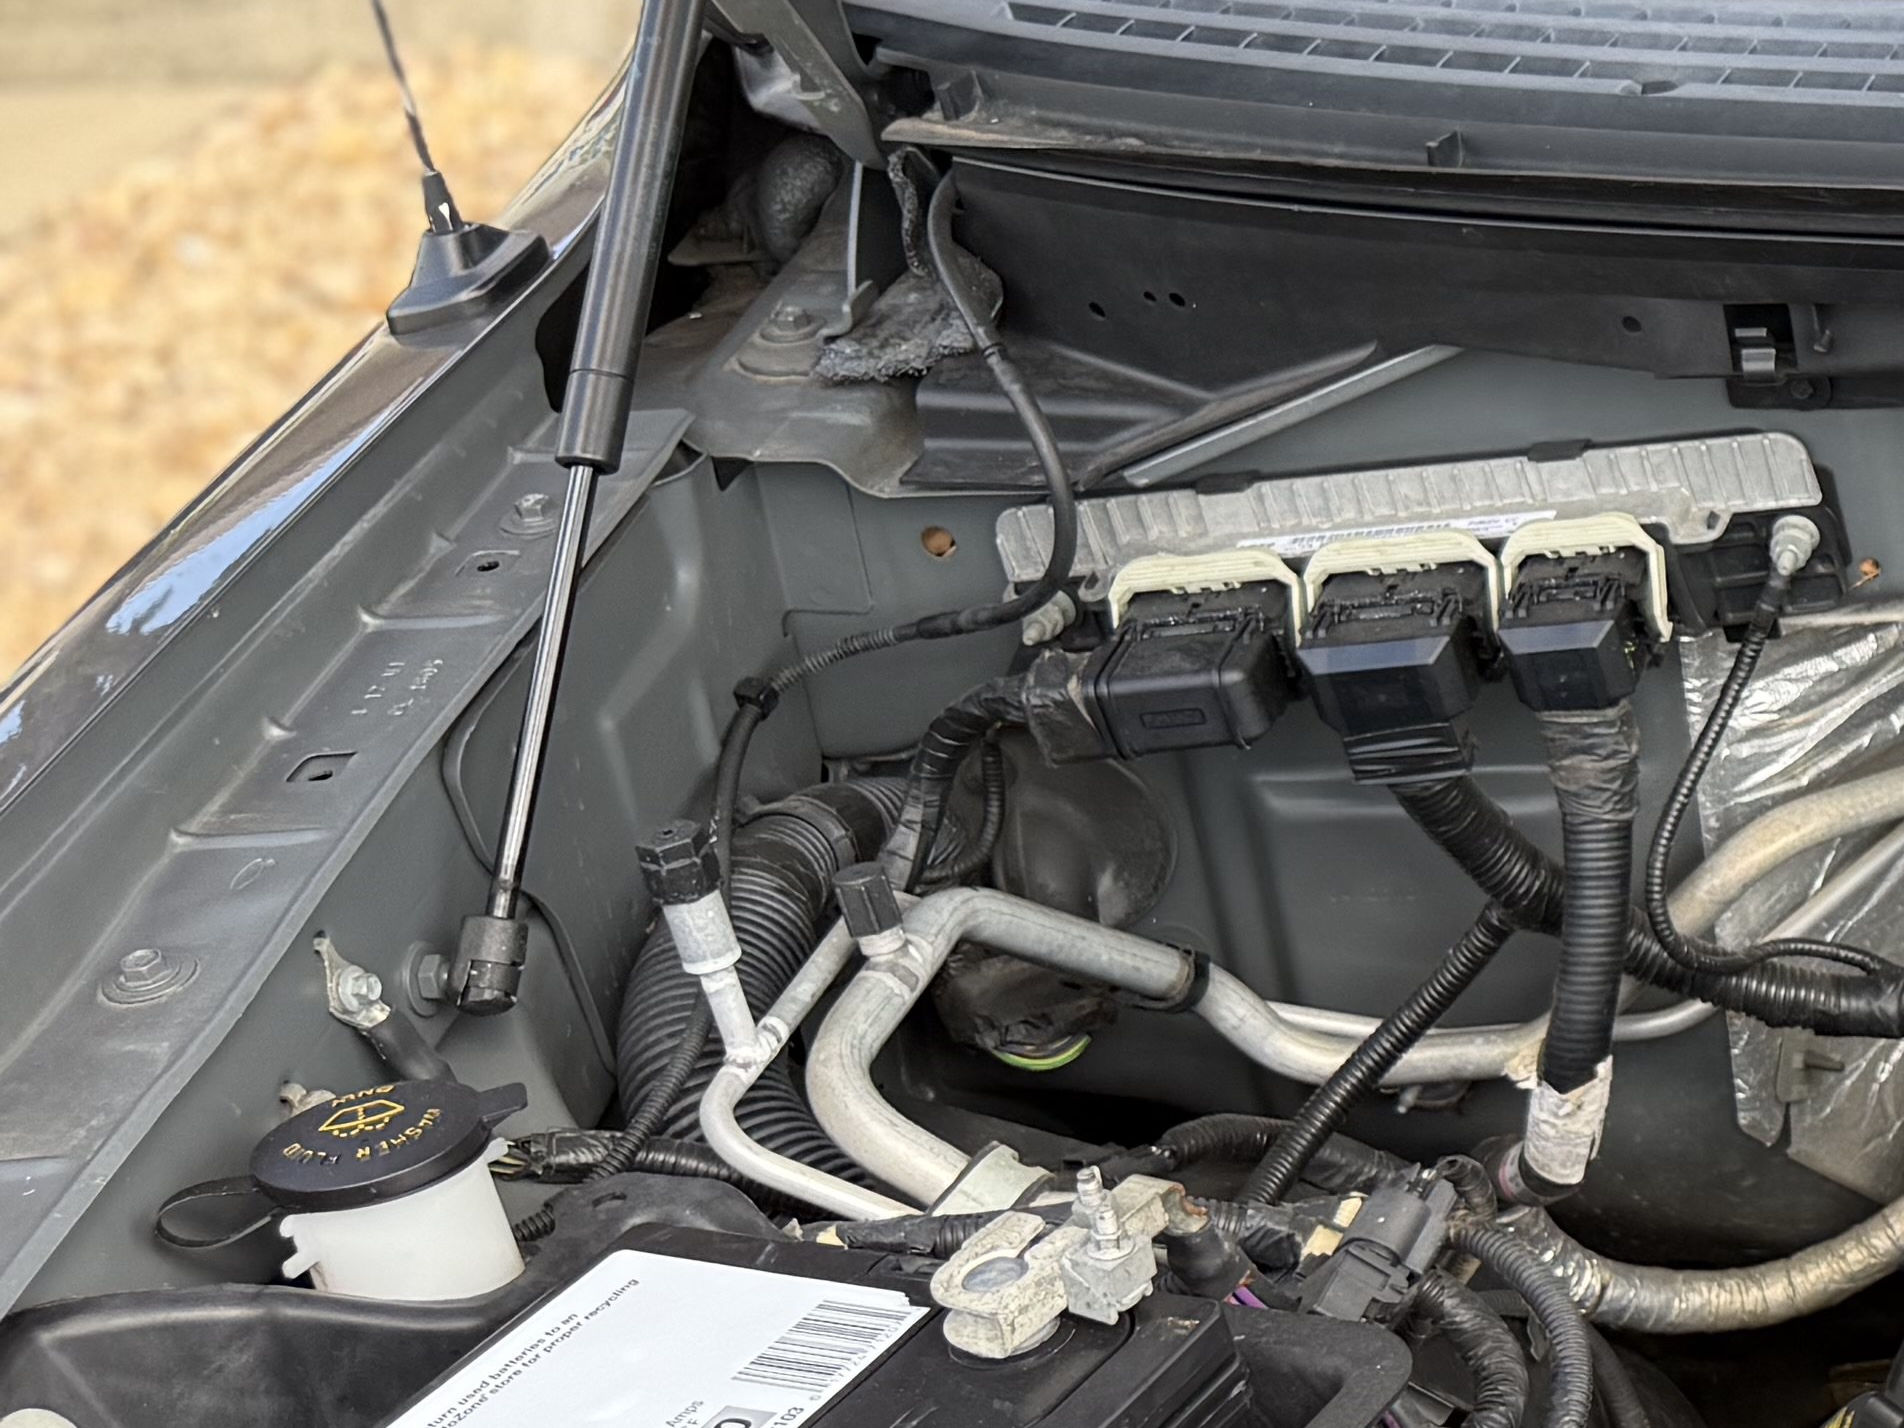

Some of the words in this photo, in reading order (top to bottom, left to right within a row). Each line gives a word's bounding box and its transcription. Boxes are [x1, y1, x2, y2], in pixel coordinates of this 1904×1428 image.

[458, 1380, 489, 1405] used
[488, 1338, 545, 1379] batteries
[544, 1326, 560, 1336] to
[561, 1313, 577, 1324] an
[489, 1369, 521, 1393] store
[521, 1353, 540, 1367] for
[543, 1321, 581, 1352] proper
[584, 1279, 638, 1319] recycling
[665, 1400, 703, 1427] Amps
